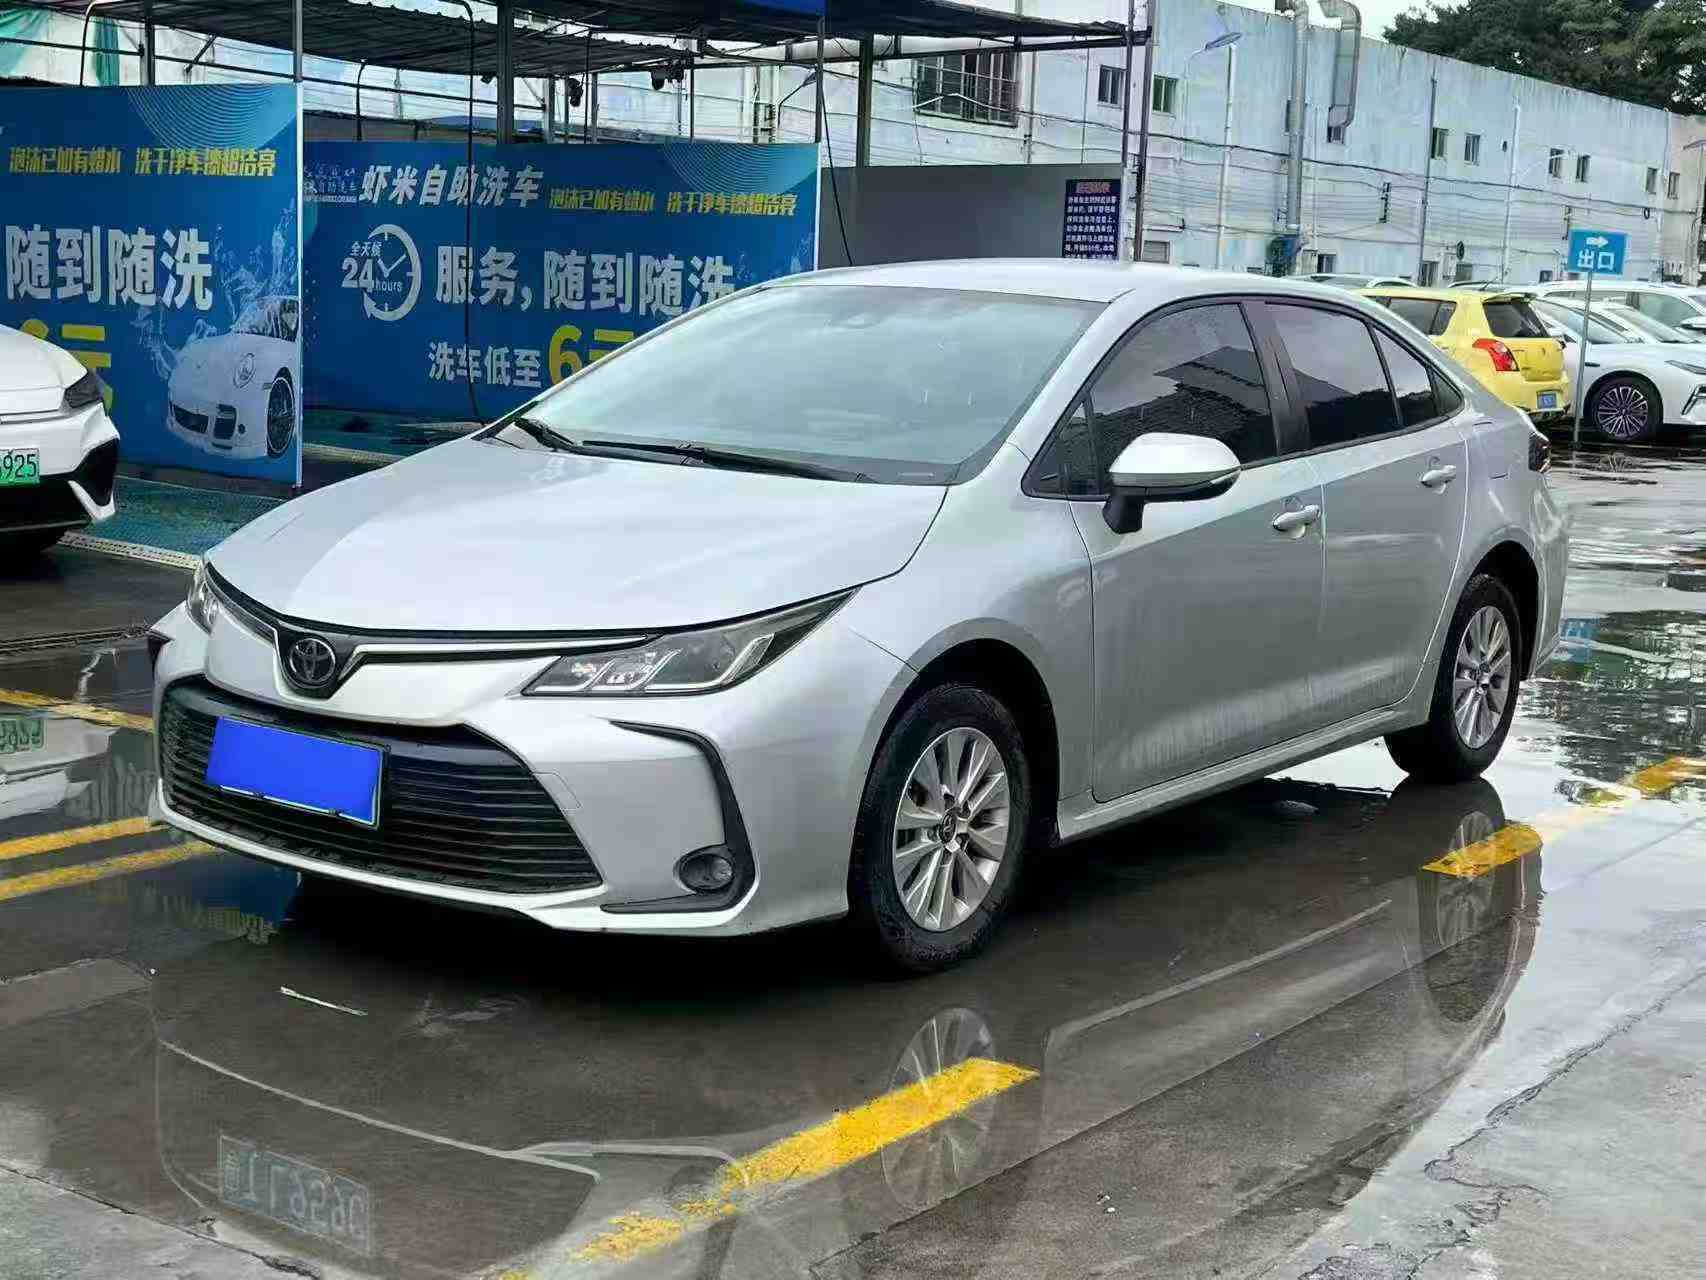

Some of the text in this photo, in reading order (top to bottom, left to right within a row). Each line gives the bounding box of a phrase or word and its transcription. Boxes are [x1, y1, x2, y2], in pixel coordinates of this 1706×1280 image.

[359, 164, 544, 208] 虾米自助洗车
[4, 224, 213, 311] 随到随洗
[341, 257, 375, 293] 24
[1577, 248, 1615, 270] 出口
